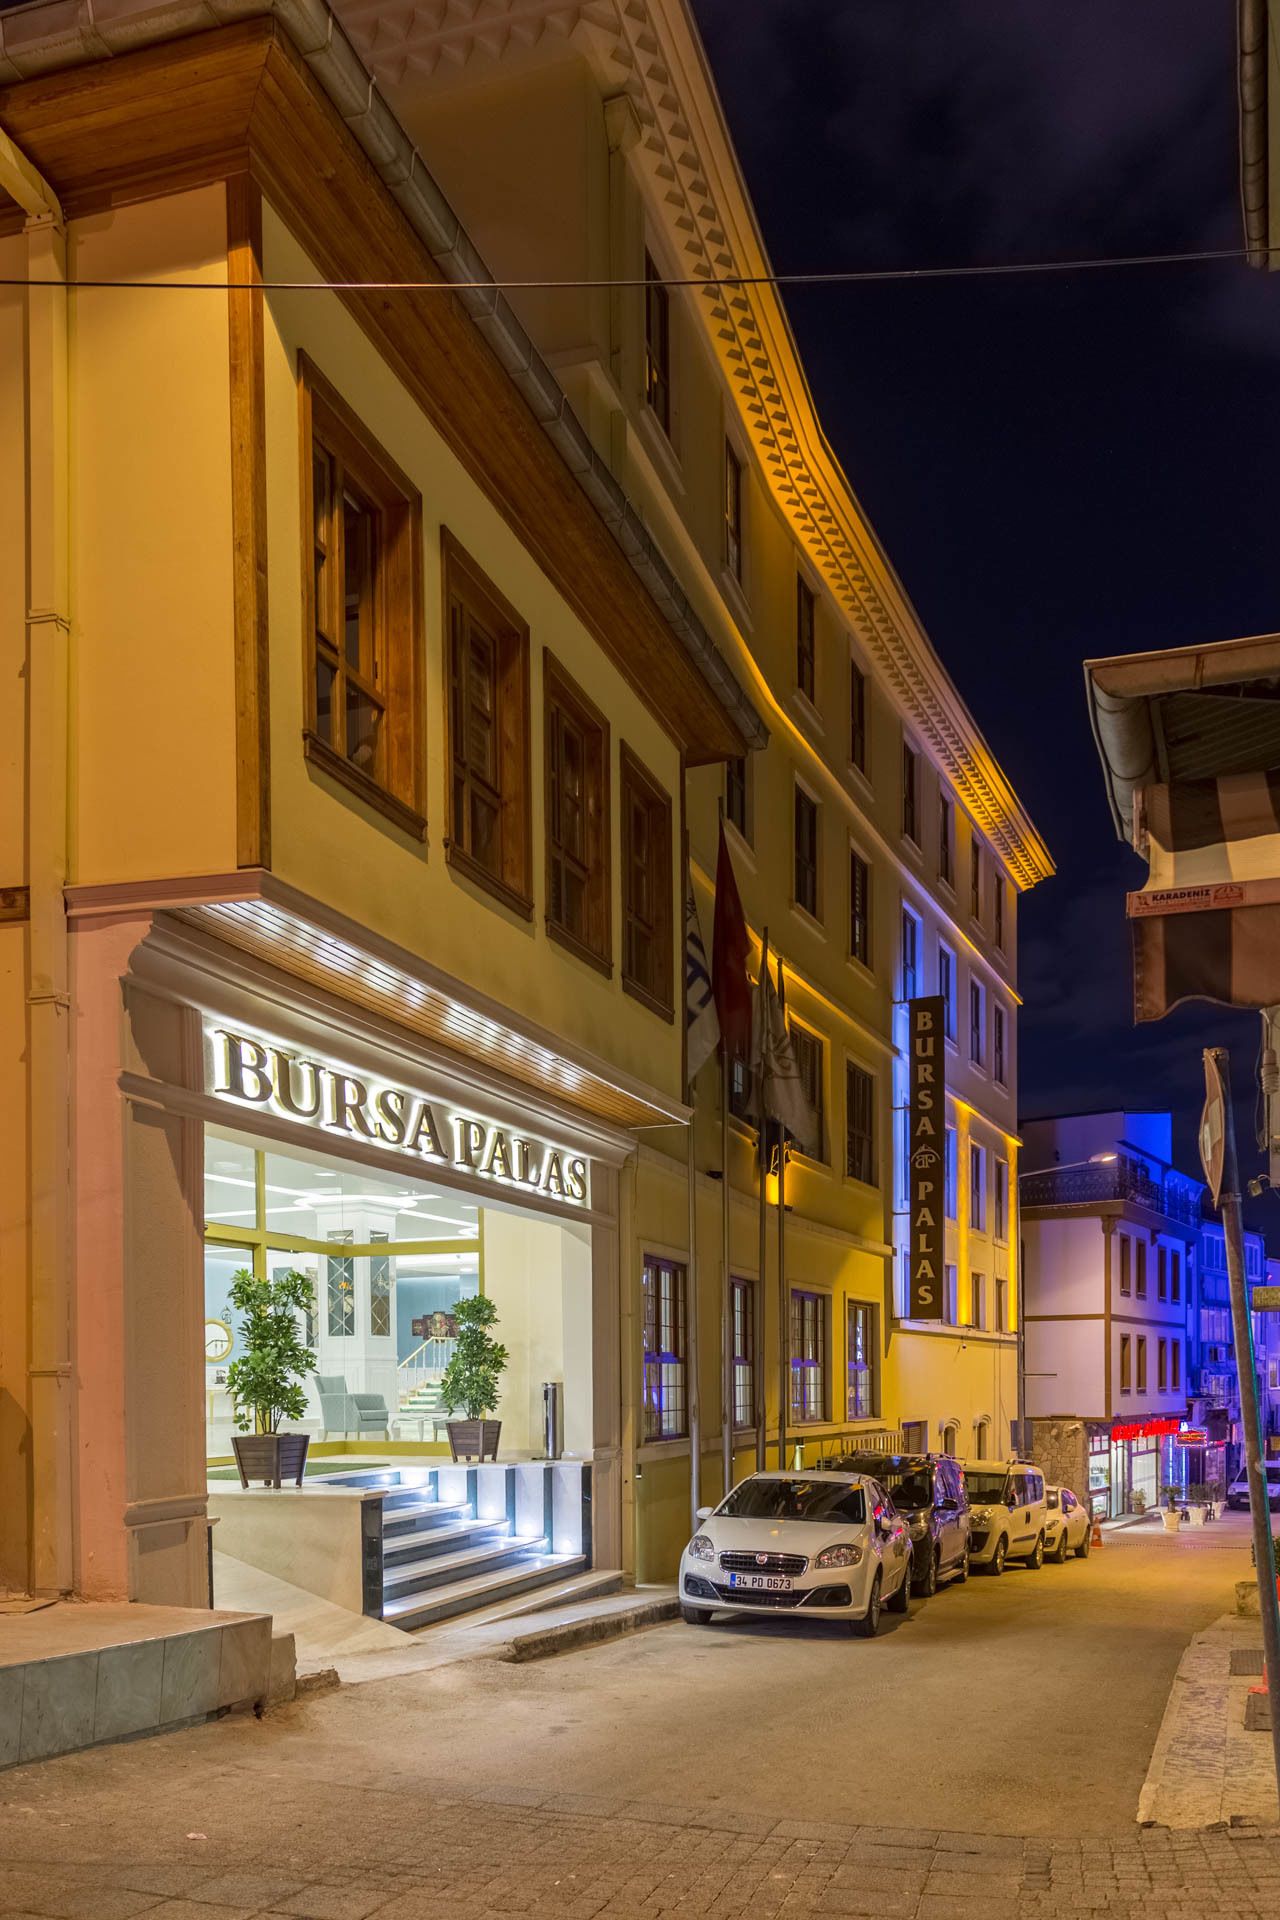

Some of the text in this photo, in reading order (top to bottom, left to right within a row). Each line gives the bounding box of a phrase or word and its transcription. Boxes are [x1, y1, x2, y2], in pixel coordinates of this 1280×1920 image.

[214, 1029, 588, 1201] BURSA PALAS
[915, 1011, 935, 1136] BURSA
[915, 1181, 935, 1305] PALAS
[736, 1576, 791, 1589] 34 PD 0673
